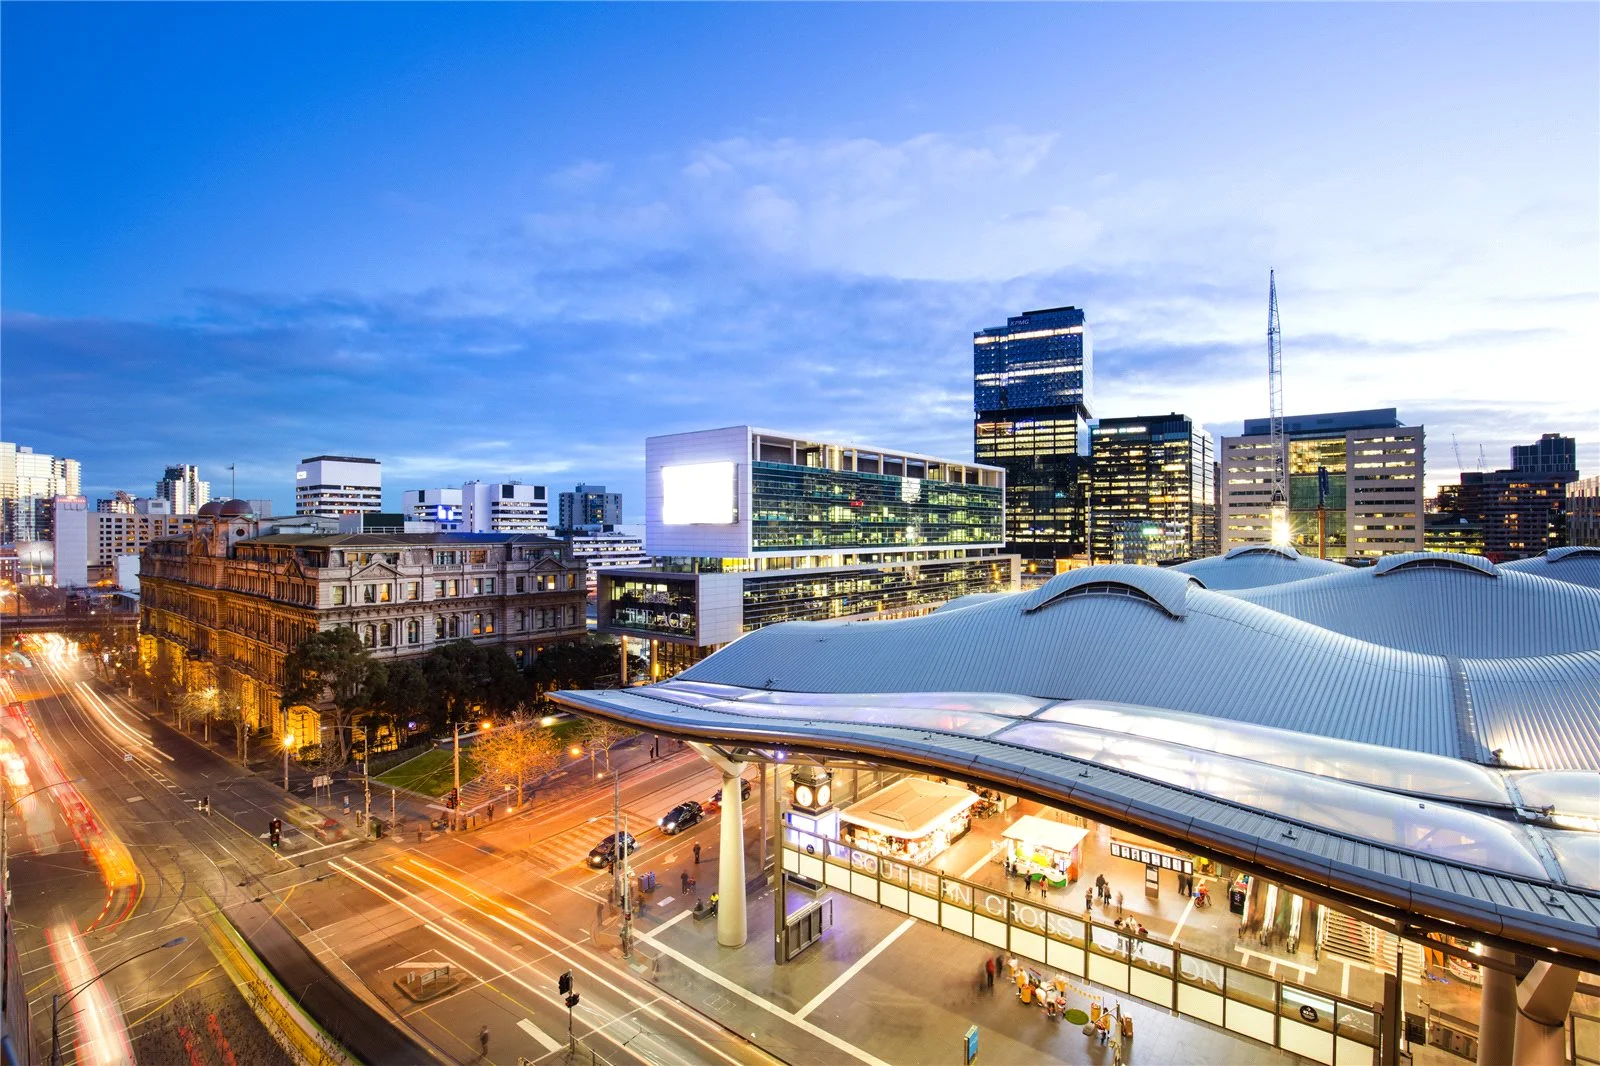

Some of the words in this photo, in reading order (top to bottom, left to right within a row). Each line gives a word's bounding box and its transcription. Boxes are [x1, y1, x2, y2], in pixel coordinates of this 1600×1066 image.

[1010, 319, 1030, 327] KPMG
[625, 607, 653, 625] THE
[658, 611, 690, 629] AGE
[985, 894, 1073, 940] CROSS
